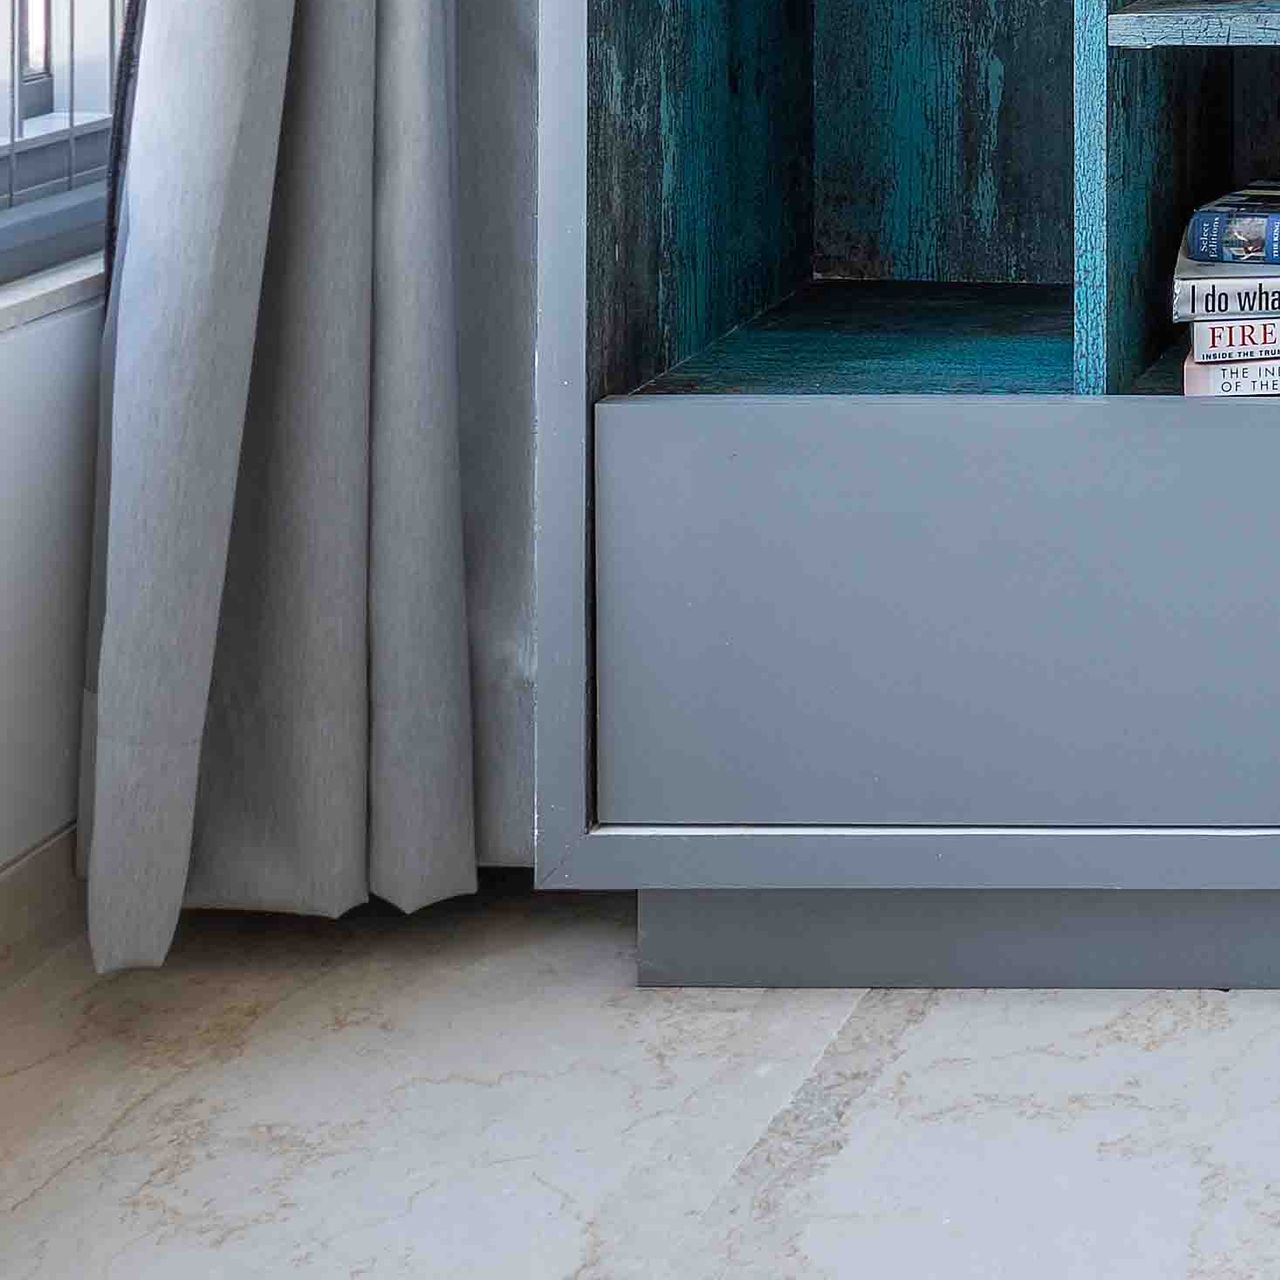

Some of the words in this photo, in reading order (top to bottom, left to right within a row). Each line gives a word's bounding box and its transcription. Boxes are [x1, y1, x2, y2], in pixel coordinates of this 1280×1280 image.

[1205, 287, 1229, 312] do
[1208, 323, 1277, 348] FIRE
[1221, 368, 1249, 379] THE
[1221, 382, 1242, 393] OF
[1251, 380, 1279, 392] THE
